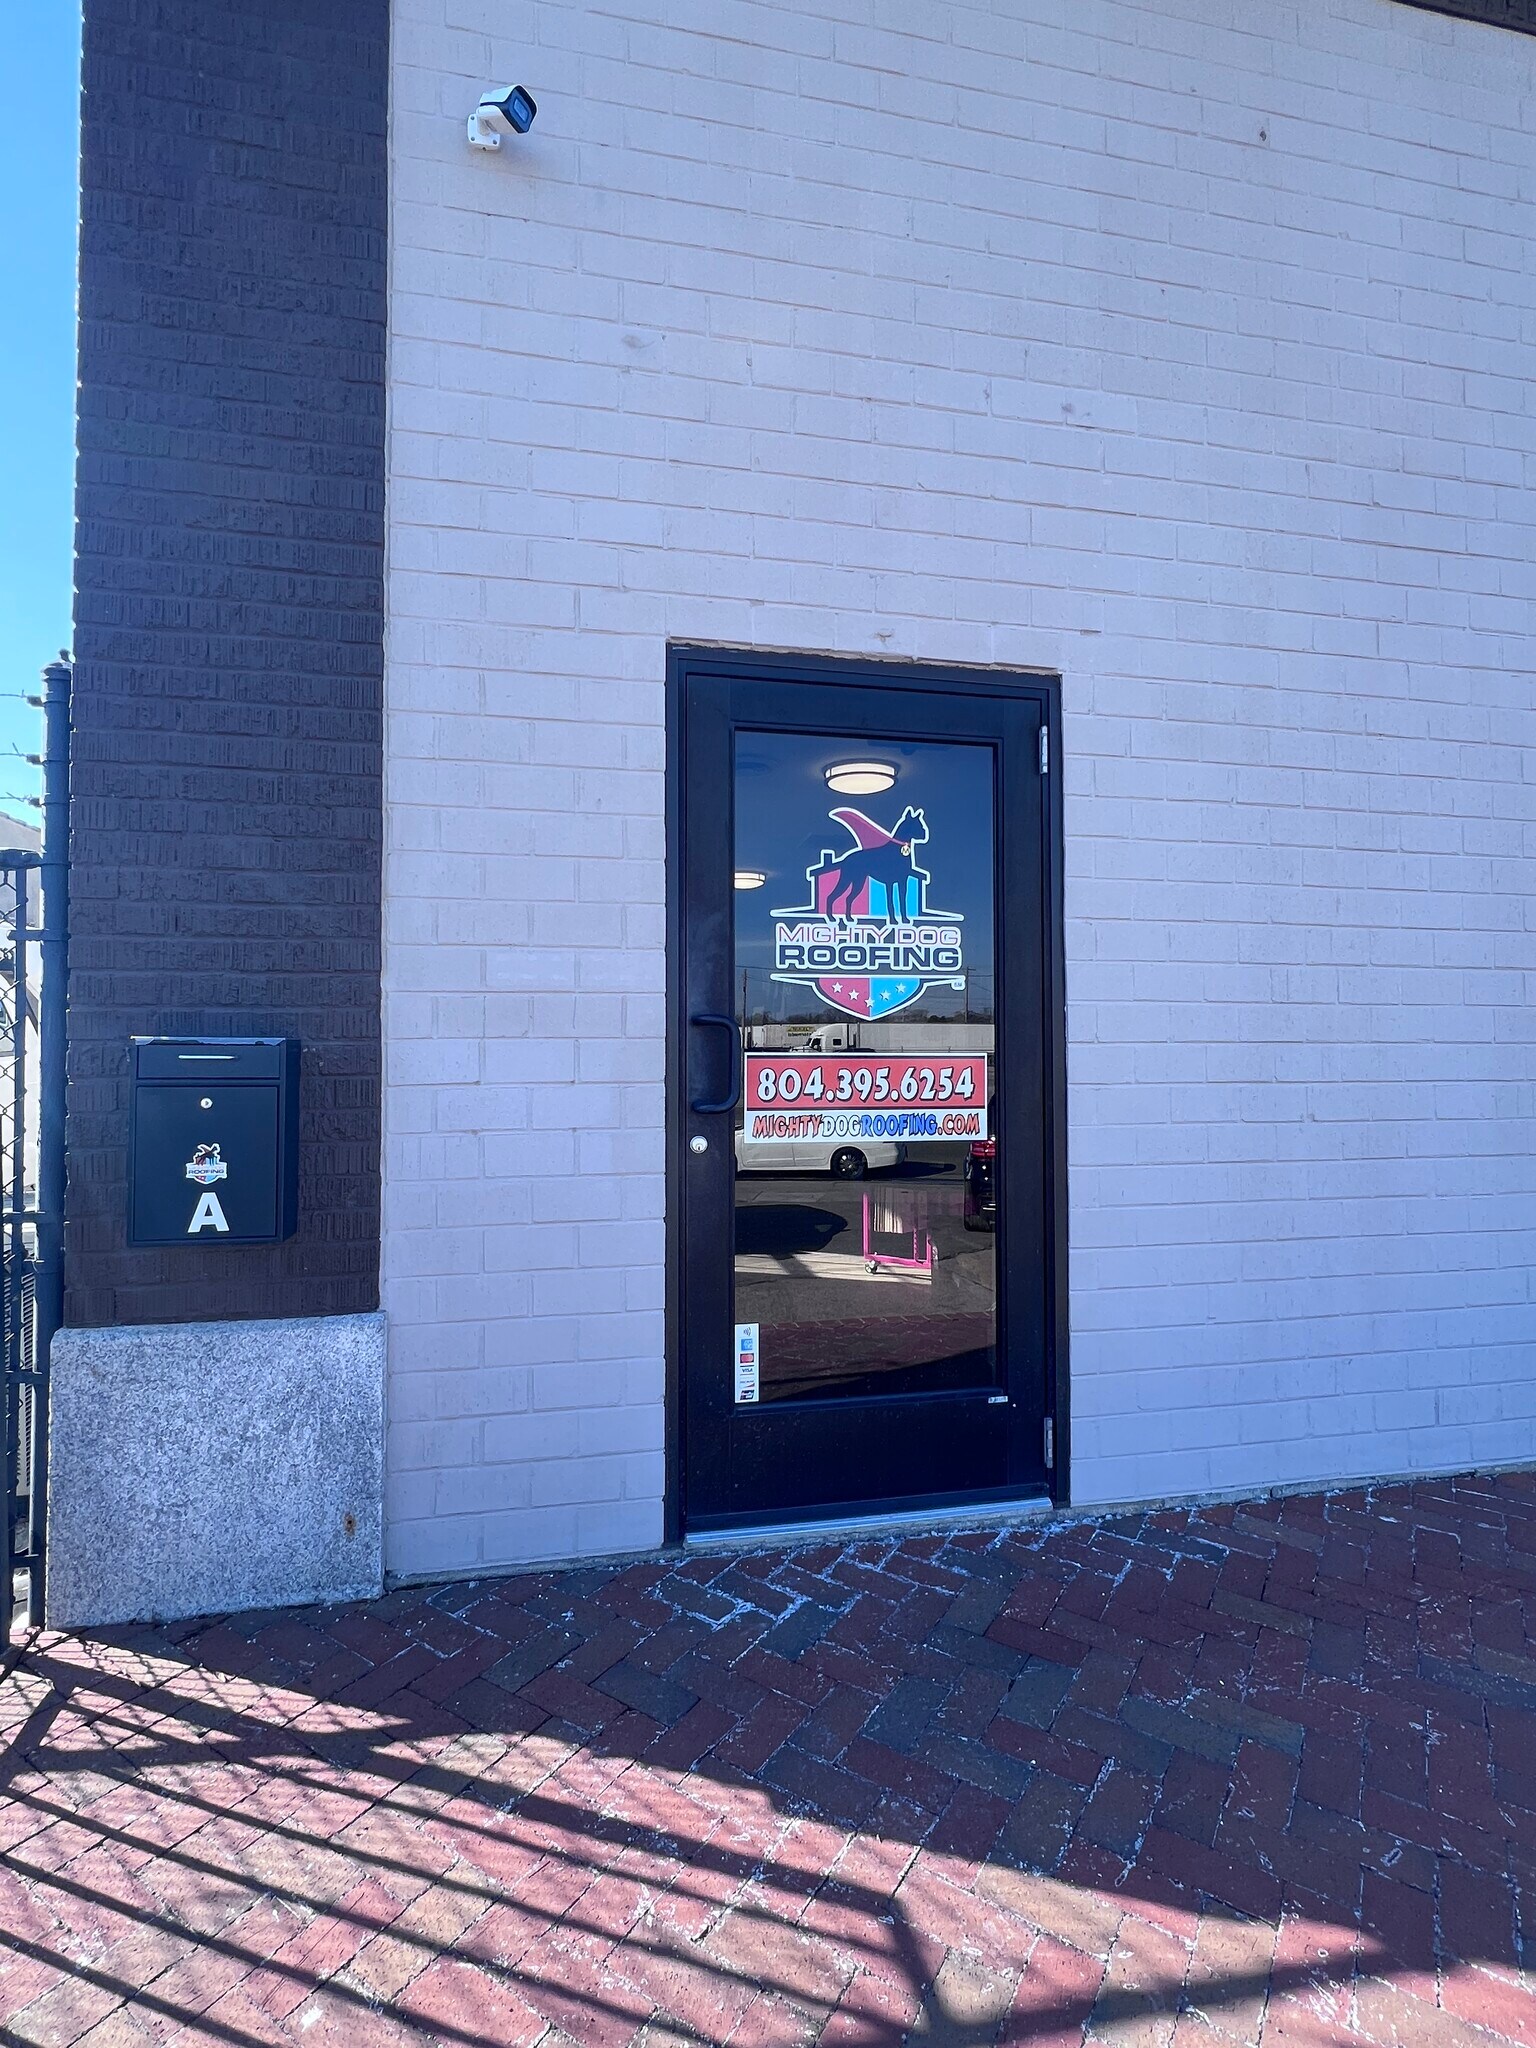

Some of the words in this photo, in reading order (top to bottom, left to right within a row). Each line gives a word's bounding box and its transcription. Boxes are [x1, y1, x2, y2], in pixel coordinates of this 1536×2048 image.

[777, 924, 891, 944] MIGHTY
[896, 926, 960, 945] DOG
[777, 944, 961, 970] ROOFING
[757, 1066, 975, 1102] 804.395.6254
[752, 1112, 981, 1139] MIGHTYDOGROOFING.COM
[187, 1192, 229, 1233] A
